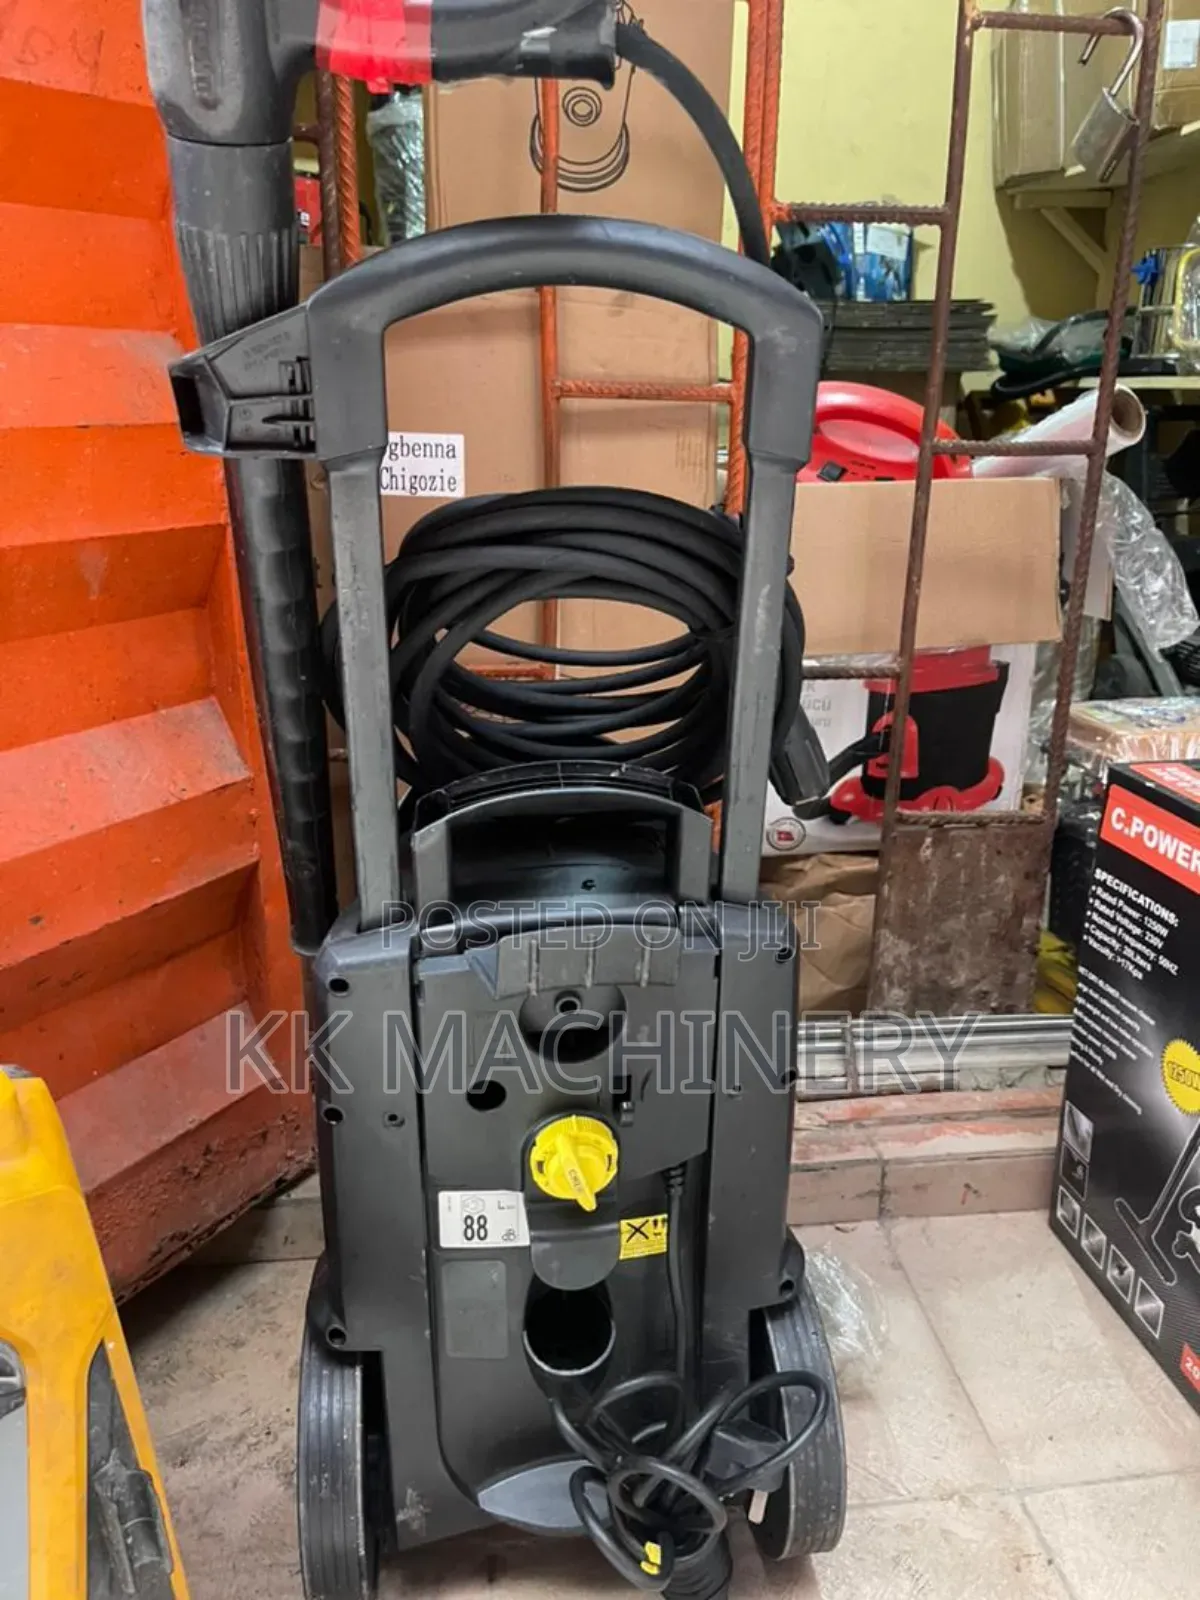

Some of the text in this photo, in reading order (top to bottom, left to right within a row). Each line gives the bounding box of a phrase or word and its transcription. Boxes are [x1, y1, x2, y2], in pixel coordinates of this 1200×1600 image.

[380, 466, 457, 496] Chigozie
[1094, 867, 1179, 927] SPECIFICATIONS:
[464, 1214, 488, 1241] 88
